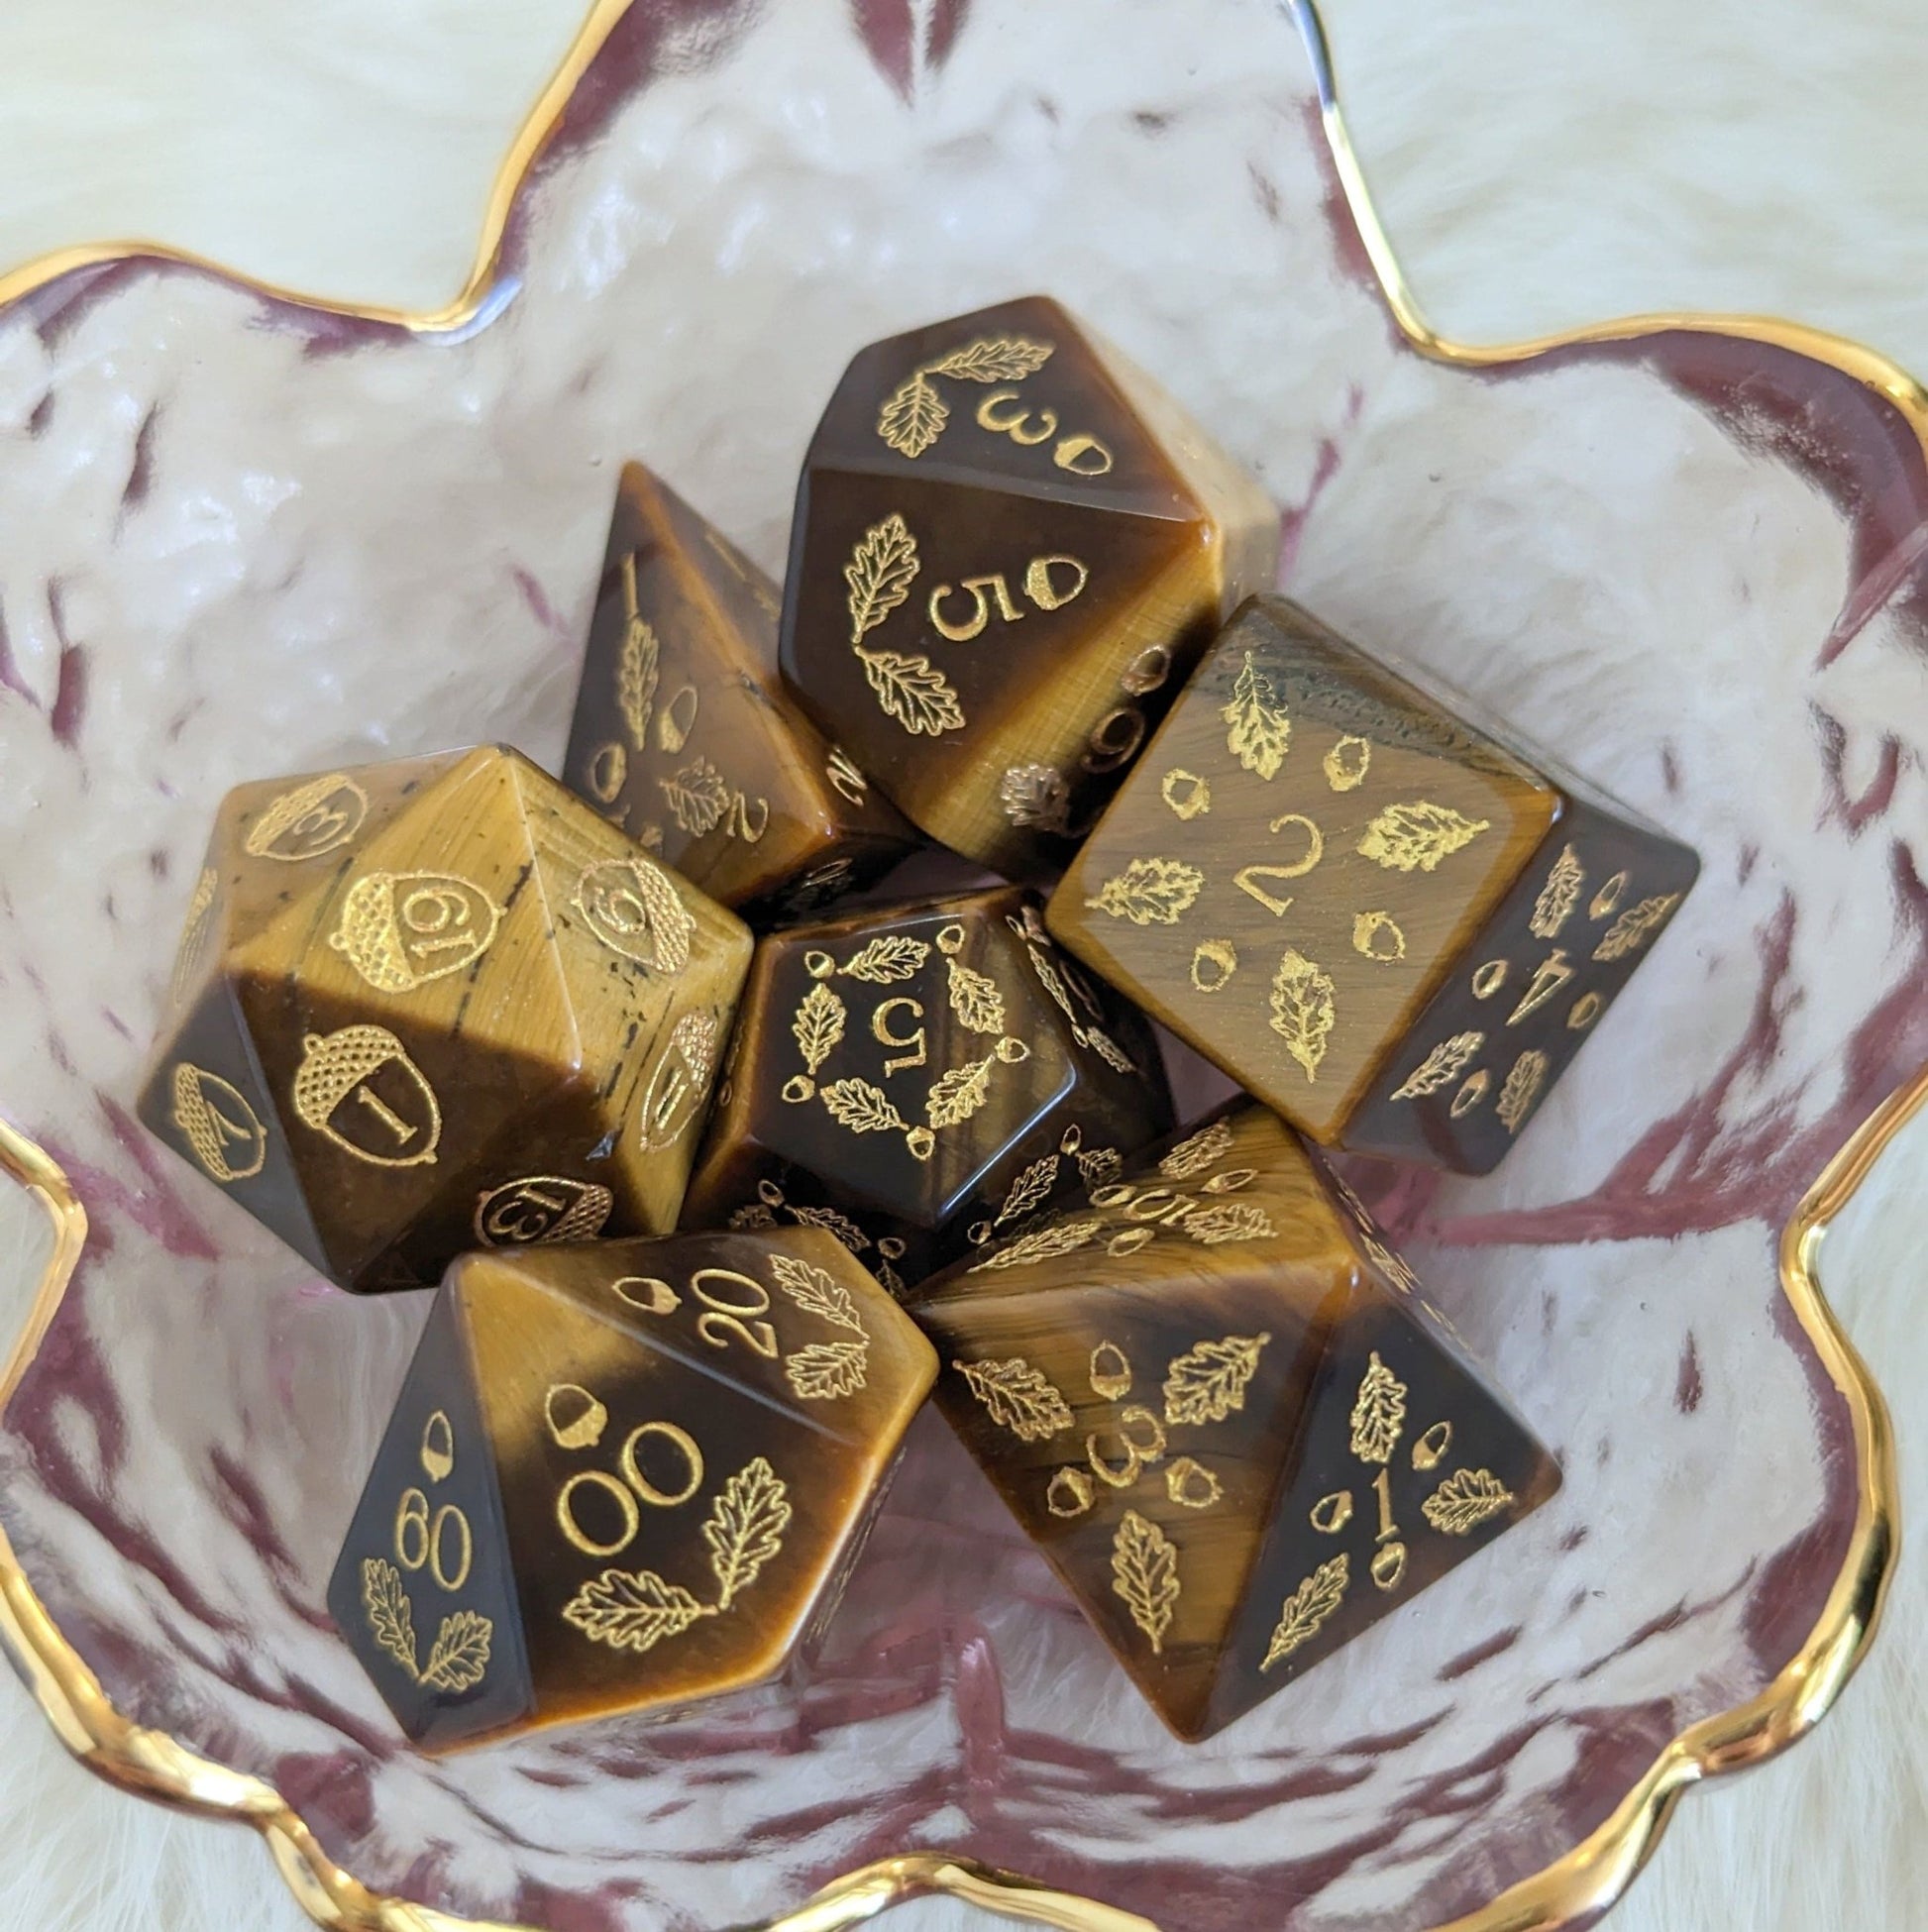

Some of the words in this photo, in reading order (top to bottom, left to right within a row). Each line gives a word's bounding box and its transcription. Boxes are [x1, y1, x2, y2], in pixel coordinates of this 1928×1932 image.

[976, 393, 1057, 446] 3
[928, 573, 1025, 642] 5
[292, 804, 349, 847] 3
[726, 791, 769, 844] 2
[1232, 812, 1325, 917] 2
[402, 887, 478, 959] 19
[1505, 947, 1574, 1027] 4
[872, 997, 927, 1079] 5
[358, 1086, 418, 1146] 1
[488, 1183, 569, 1241] 13
[691, 1268, 779, 1359] 20
[1086, 1405, 1167, 1488] 3
[557, 1421, 704, 1557] 00
[1371, 1467, 1399, 1543] 1
[395, 1486, 474, 1592] 60
